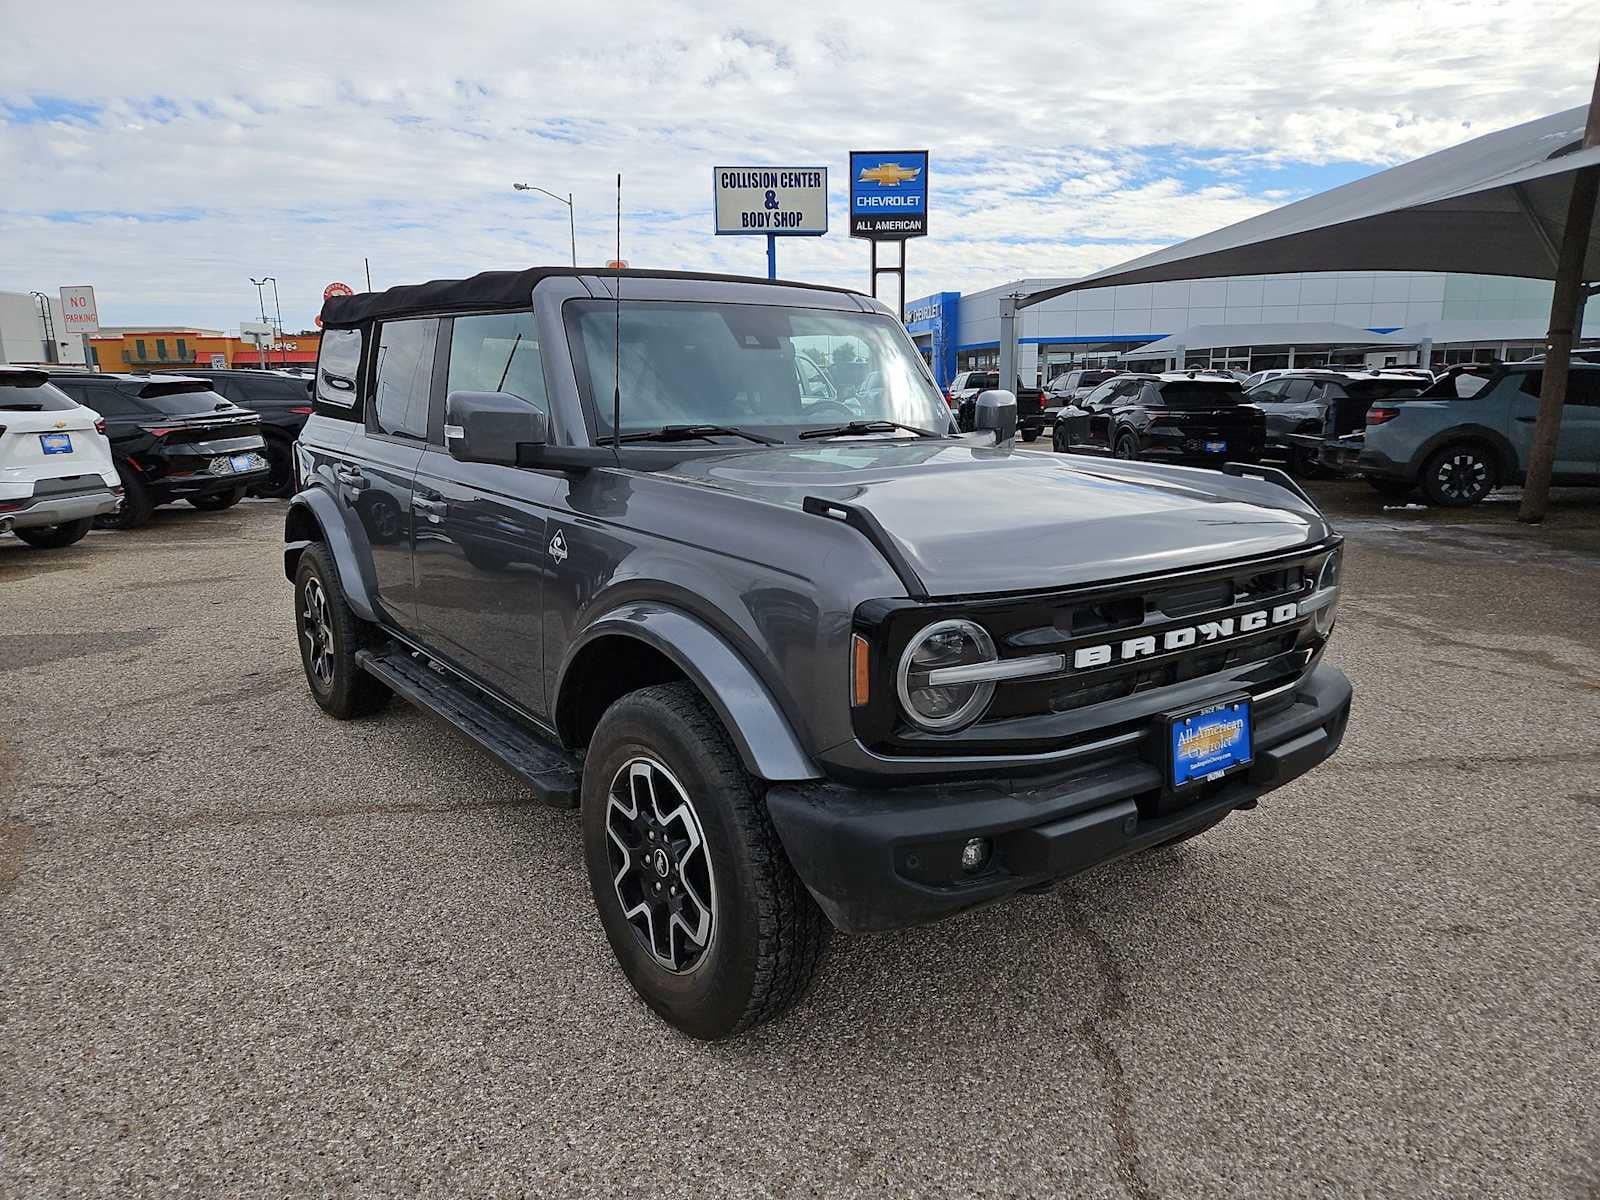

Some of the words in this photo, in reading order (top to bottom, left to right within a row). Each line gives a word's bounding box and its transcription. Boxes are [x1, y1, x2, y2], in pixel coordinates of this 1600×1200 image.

[721, 172, 778, 189] COLLISION
[780, 172, 821, 188] CENTER
[764, 189, 779, 210] &
[856, 196, 921, 207] CHEVROLET
[741, 211, 771, 228] BODY
[773, 211, 803, 228] SHOP
[856, 220, 873, 230] ALL
[875, 220, 922, 230] AMERICAN
[70, 296, 86, 307] NO
[65, 313, 96, 323] PARKING
[1074, 602, 1298, 669] BRONCO
[1178, 728, 1193, 747] All
[1197, 718, 1244, 739] American
